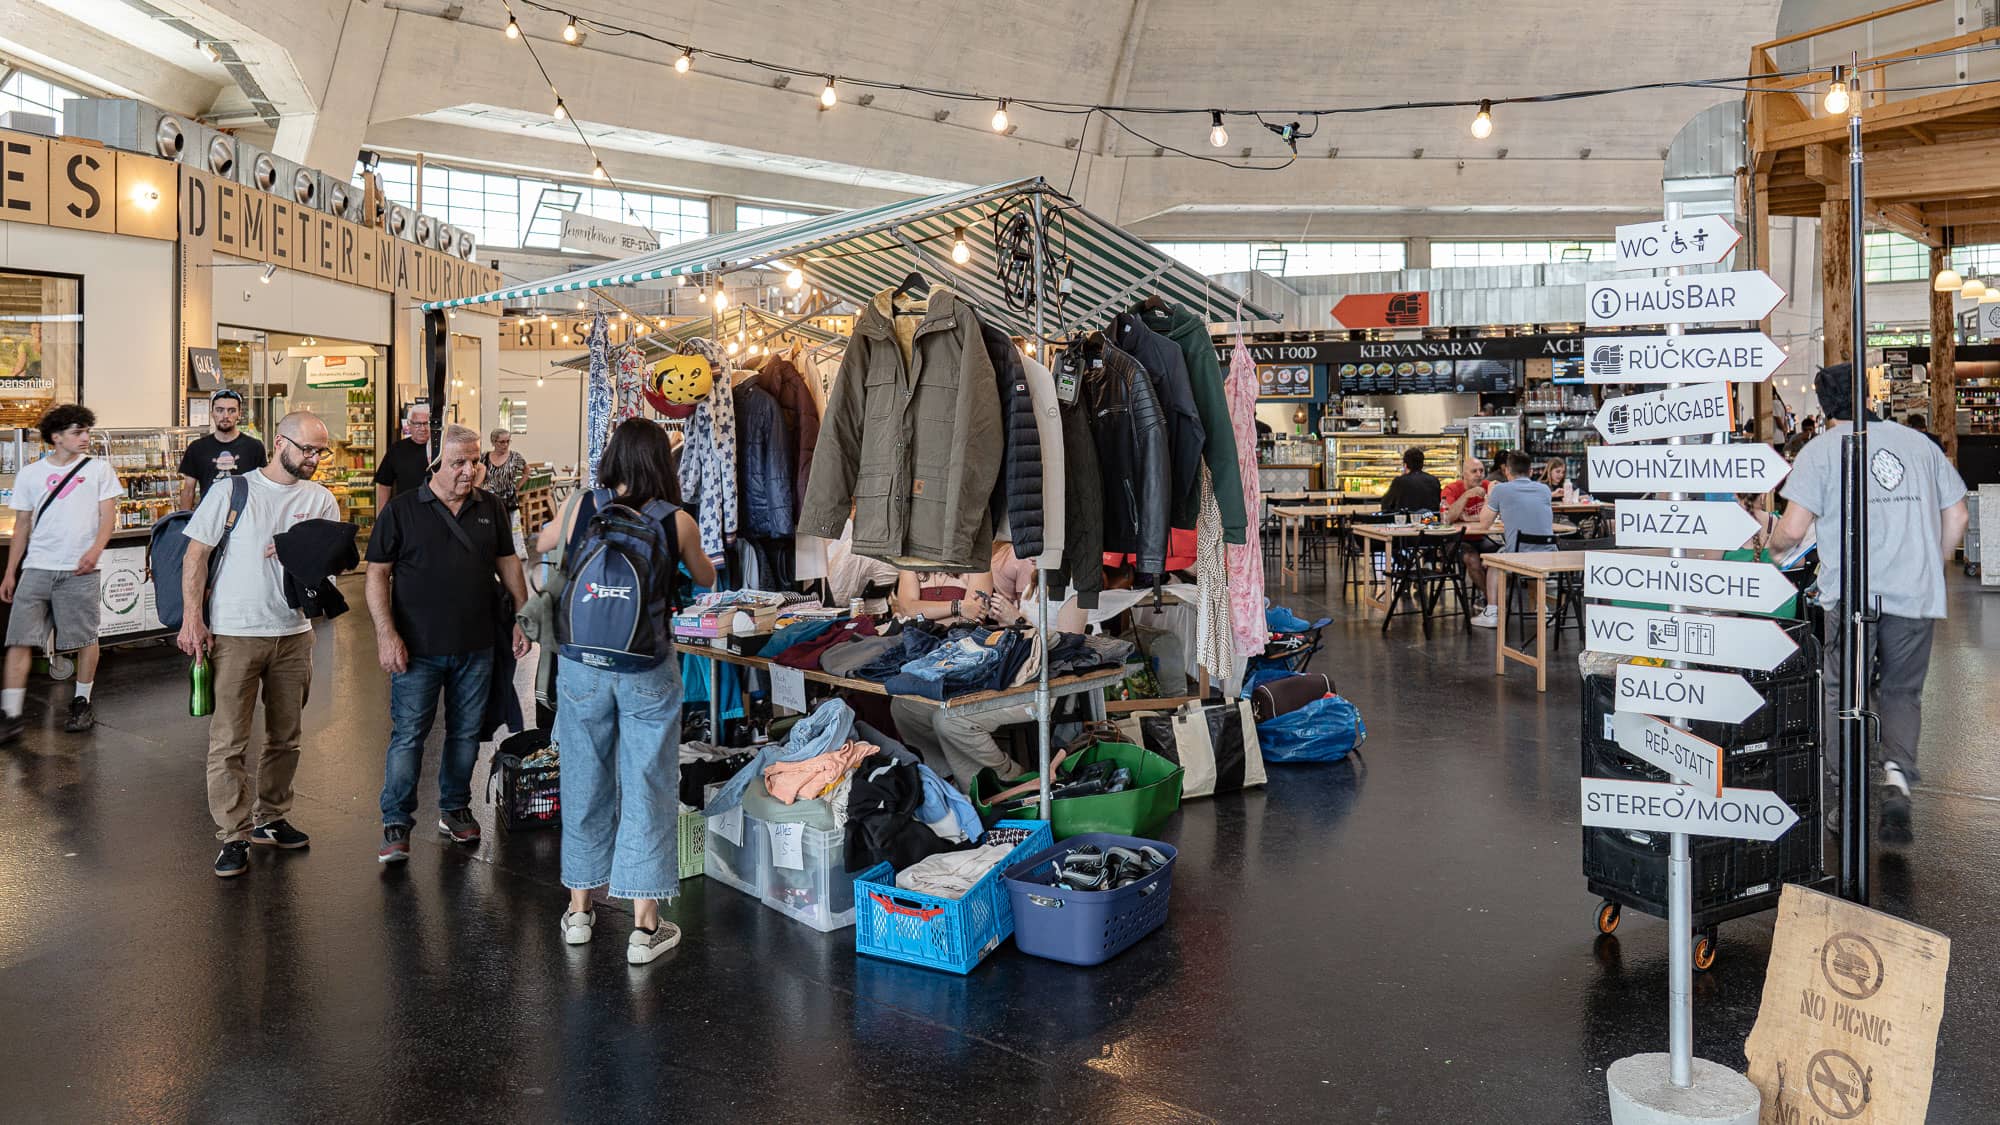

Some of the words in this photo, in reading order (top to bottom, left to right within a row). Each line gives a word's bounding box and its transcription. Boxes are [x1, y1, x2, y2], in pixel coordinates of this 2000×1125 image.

[1620, 236, 1658, 258] WC
[1280, 346, 1318, 360] FOOD
[1359, 341, 1487, 358] KERVANSARAY
[1541, 338, 1585, 354] ACE
[1629, 345, 1763, 369] RÜCKGABE
[1633, 396, 1724, 427] RÜCKGABE
[1592, 458, 1765, 478] WOHNZIMMER
[1621, 513, 1708, 535] PIAZZA
[1591, 565, 1760, 598] KOCHNISCHE
[1591, 619, 1634, 642] WC
[1621, 677, 1705, 705] SALON
[1645, 729, 1714, 780] REP-STATT
[1587, 792, 1785, 826] STEREO/MONO
[1800, 989, 1826, 1022] NO
[1832, 1001, 1893, 1047] PICNIC
